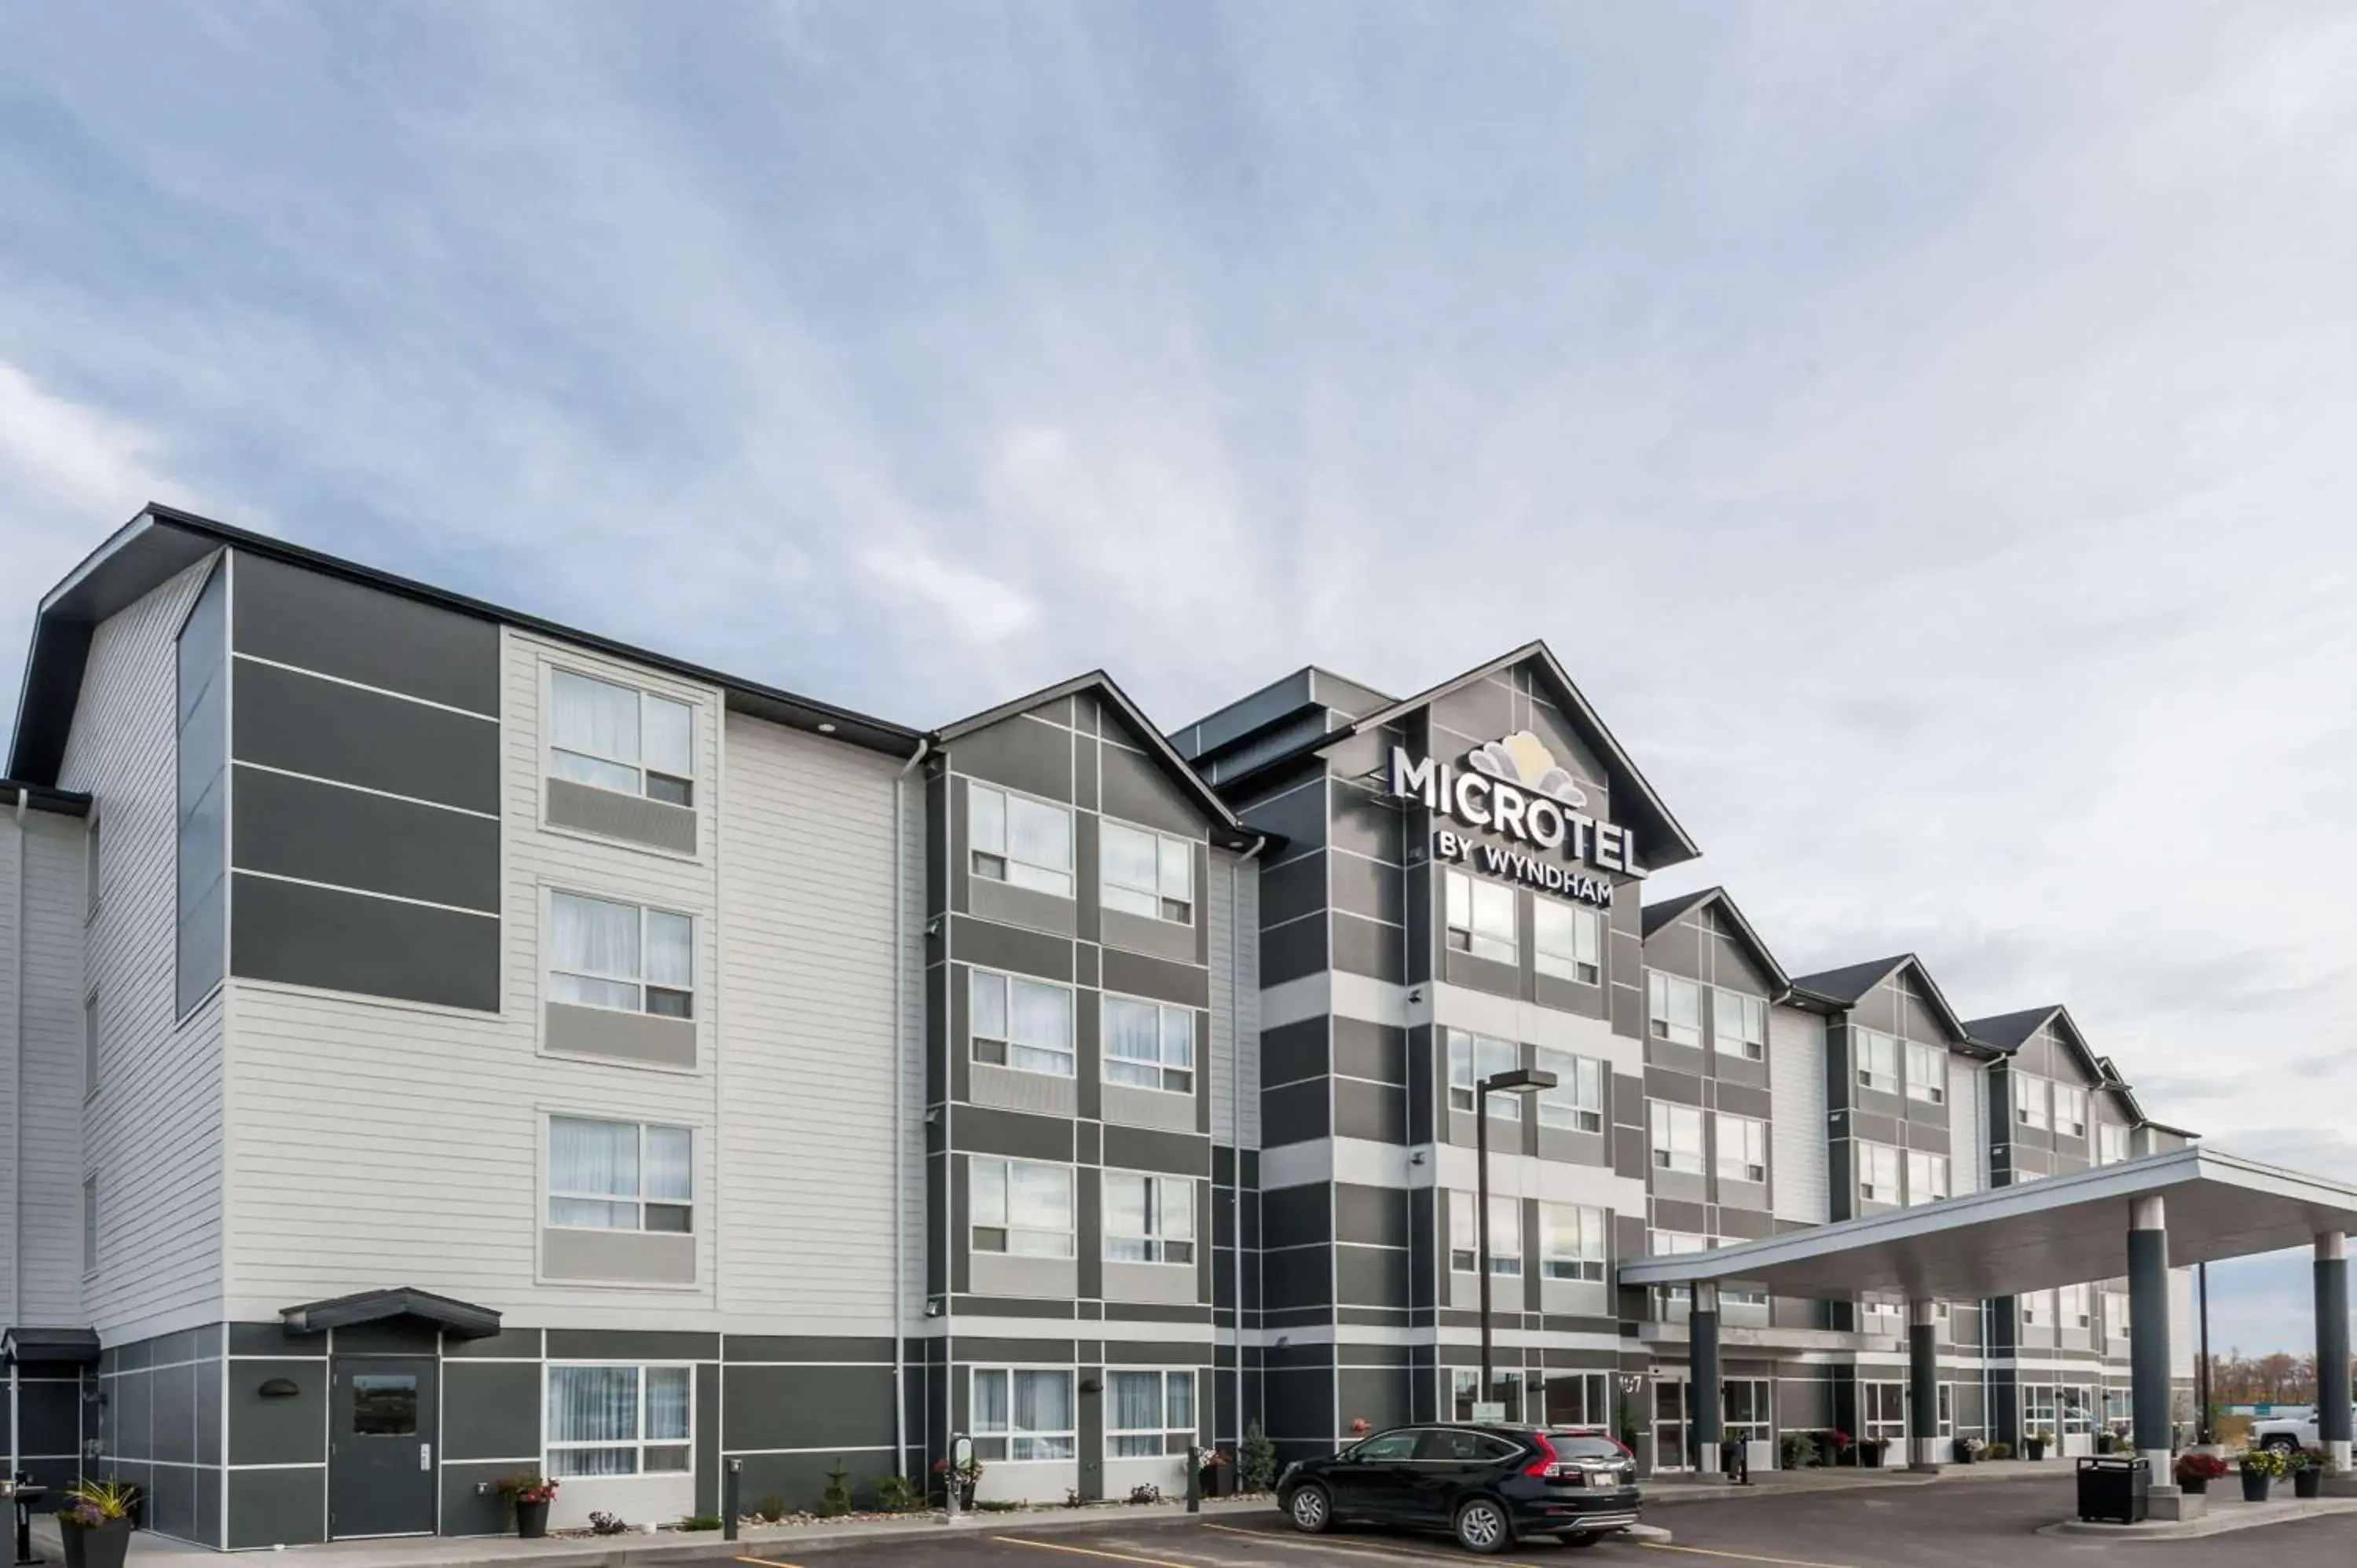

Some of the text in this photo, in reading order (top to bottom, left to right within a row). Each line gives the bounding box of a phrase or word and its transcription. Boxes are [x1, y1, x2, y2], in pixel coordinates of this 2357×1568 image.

[1393, 746, 1648, 880] MICROTEL
[1439, 830, 1614, 906] BY WYNDHAM
